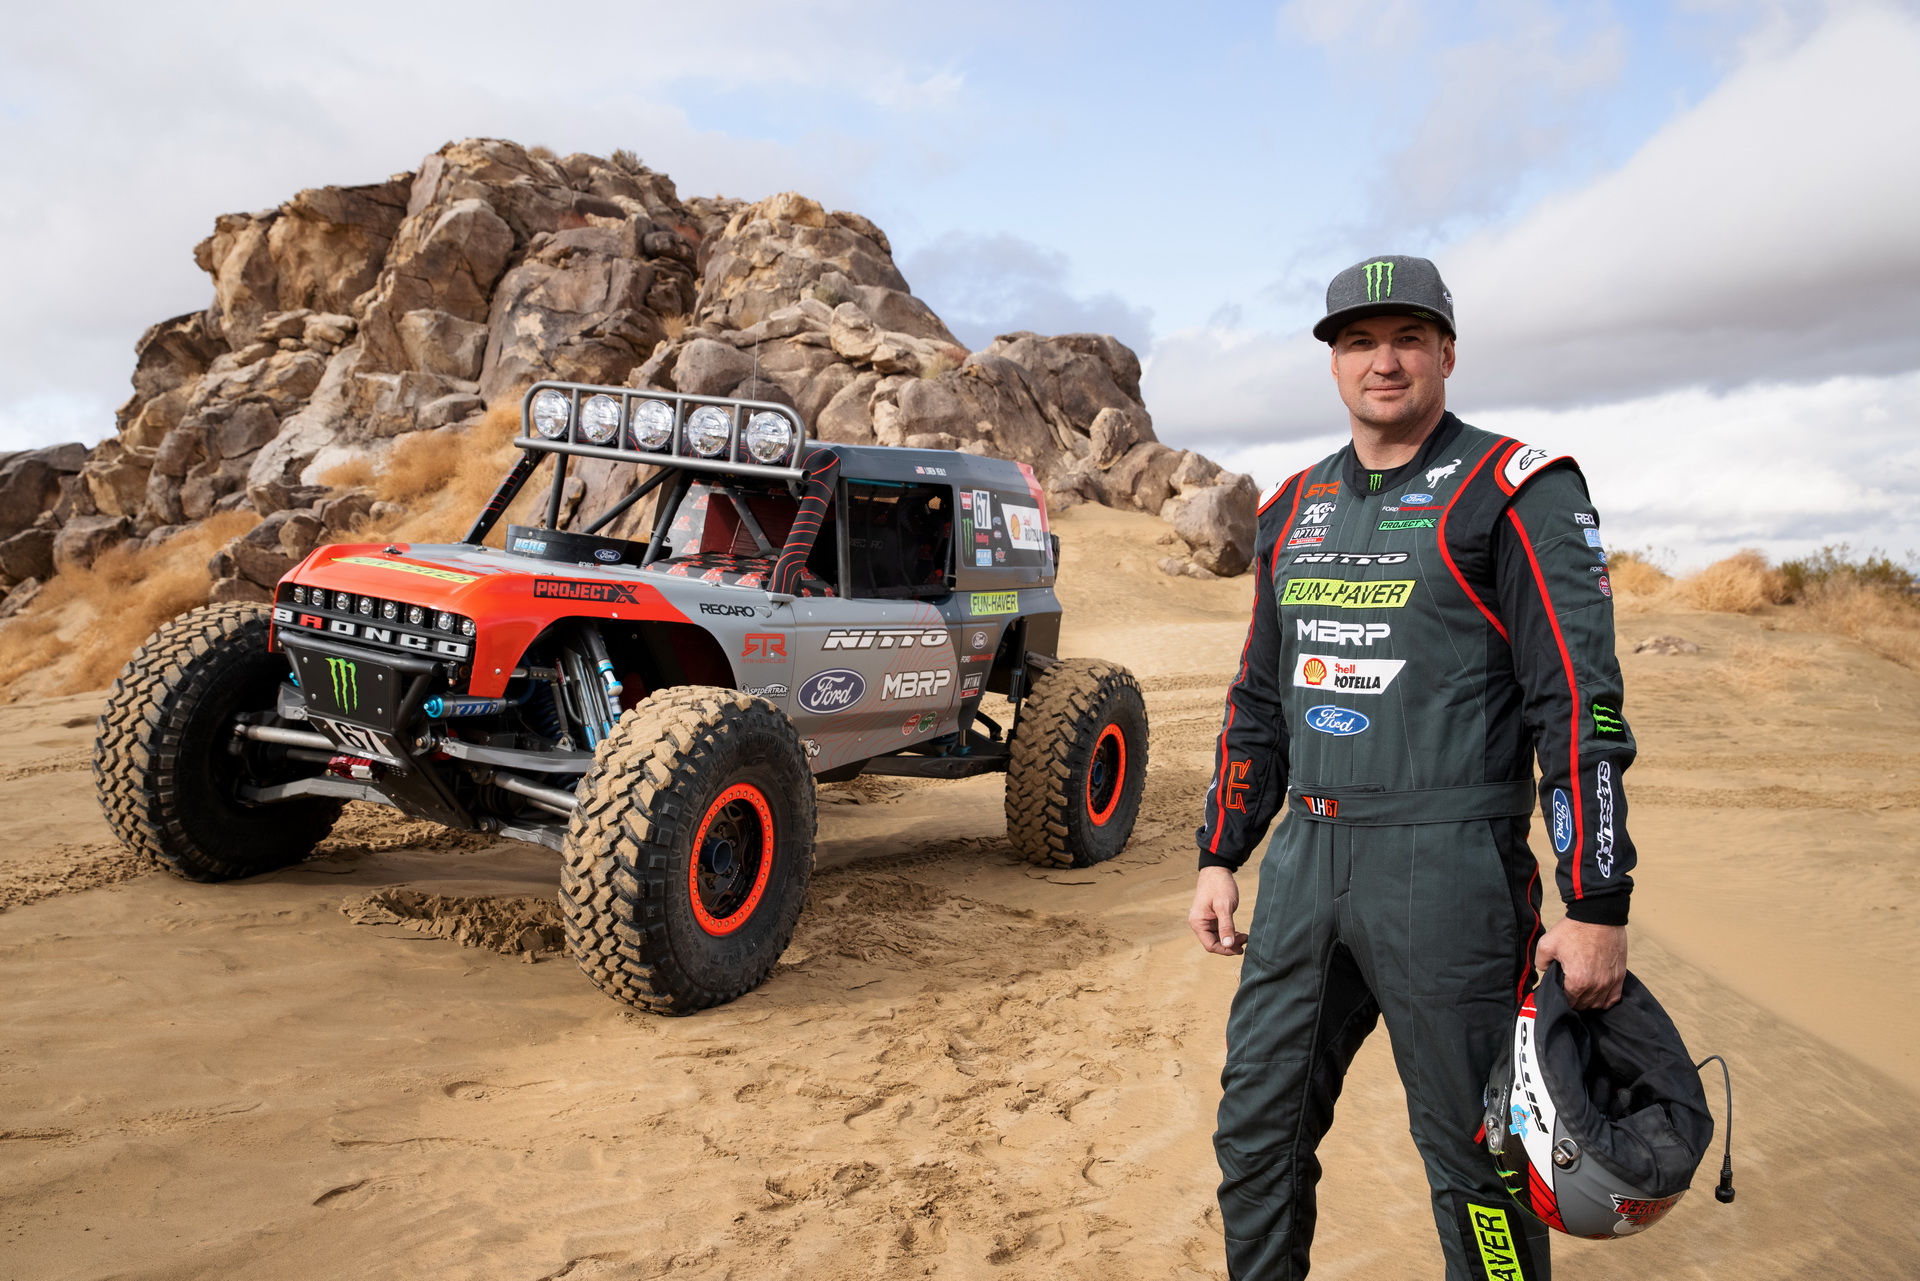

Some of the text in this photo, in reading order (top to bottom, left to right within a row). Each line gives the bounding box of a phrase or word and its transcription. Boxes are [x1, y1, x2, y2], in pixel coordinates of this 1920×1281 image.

[976, 492, 987, 527] 67
[1293, 527, 1328, 539] OPTIMA
[600, 550, 616, 559] Ford
[1293, 552, 1409, 565] NITTO
[700, 603, 755, 617] RECARO
[973, 594, 1016, 612] FUN-HAVER
[822, 630, 948, 649] NITTO
[1296, 619, 1391, 645] MBRP
[811, 676, 852, 706] Ford
[882, 670, 950, 700] MBRP
[335, 722, 380, 753] 67
[1310, 797, 1338, 817] LH67
[1555, 801, 1569, 840] Ford
